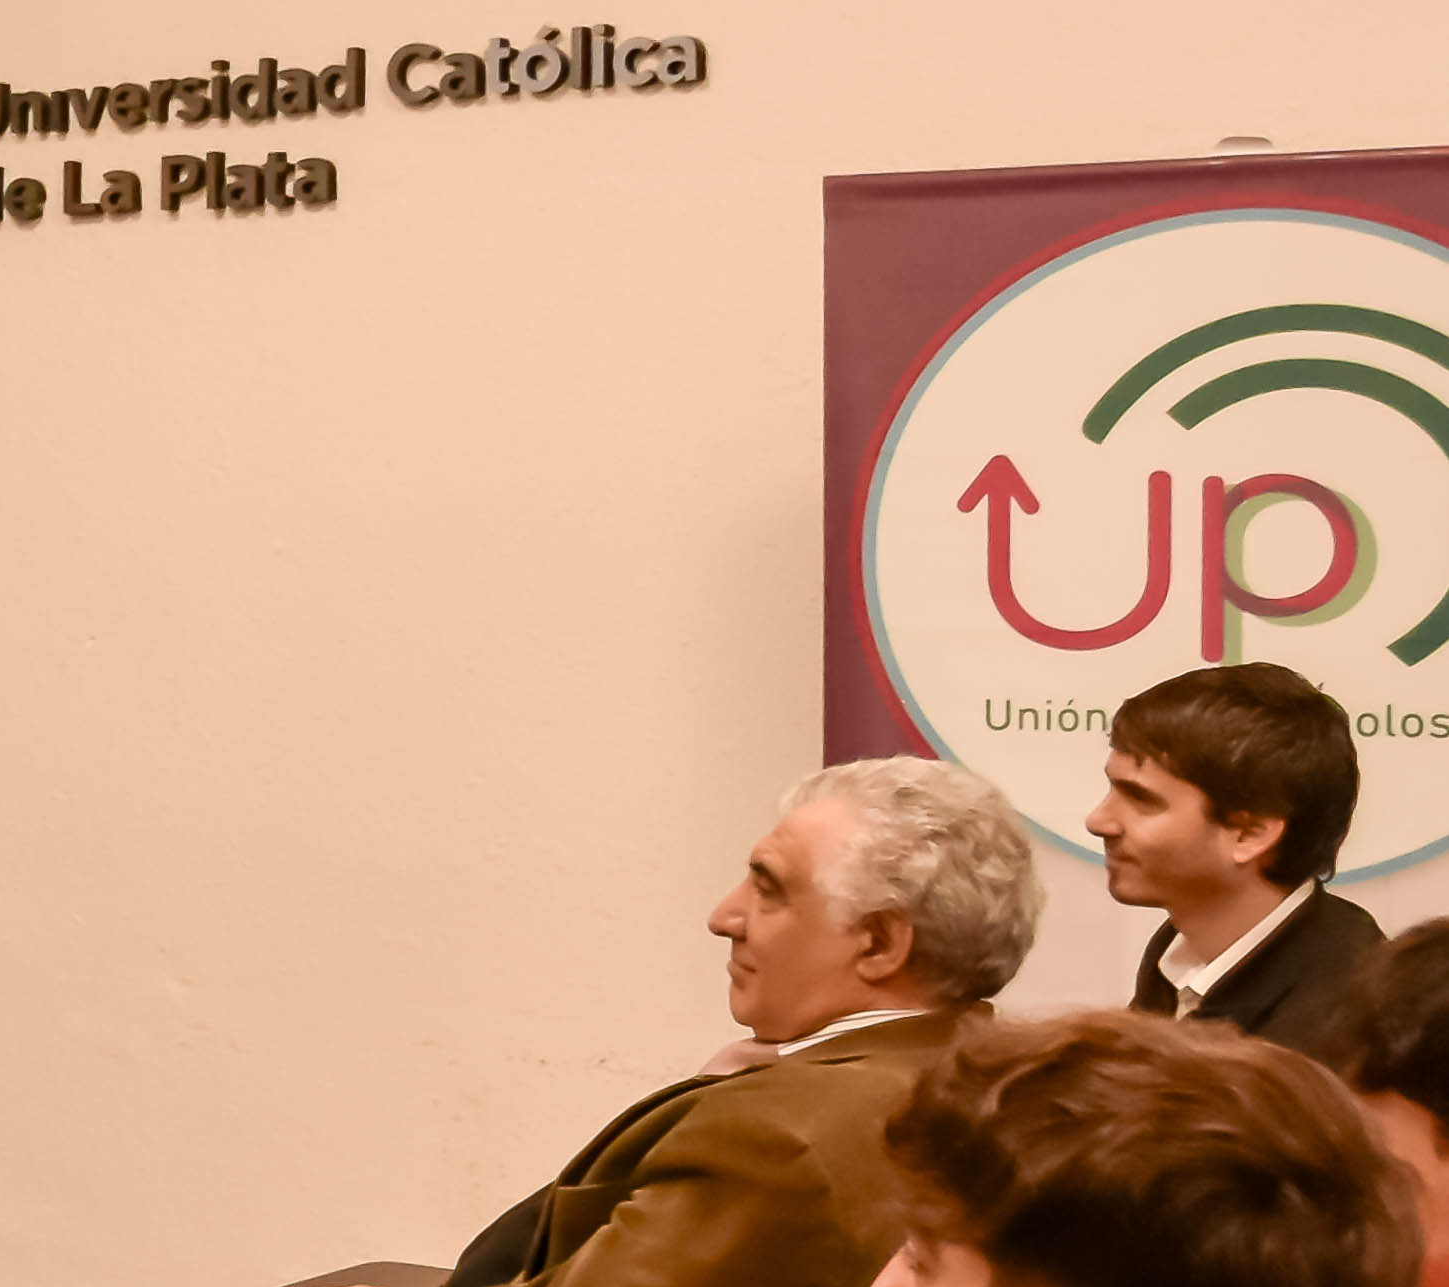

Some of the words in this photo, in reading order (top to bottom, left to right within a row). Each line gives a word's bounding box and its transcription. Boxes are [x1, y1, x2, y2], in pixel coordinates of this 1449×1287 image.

[386, 24, 708, 110] Católica
[61, 160, 143, 221] La
[159, 149, 339, 217] Plata
[1356, 703, 1449, 739] olos
